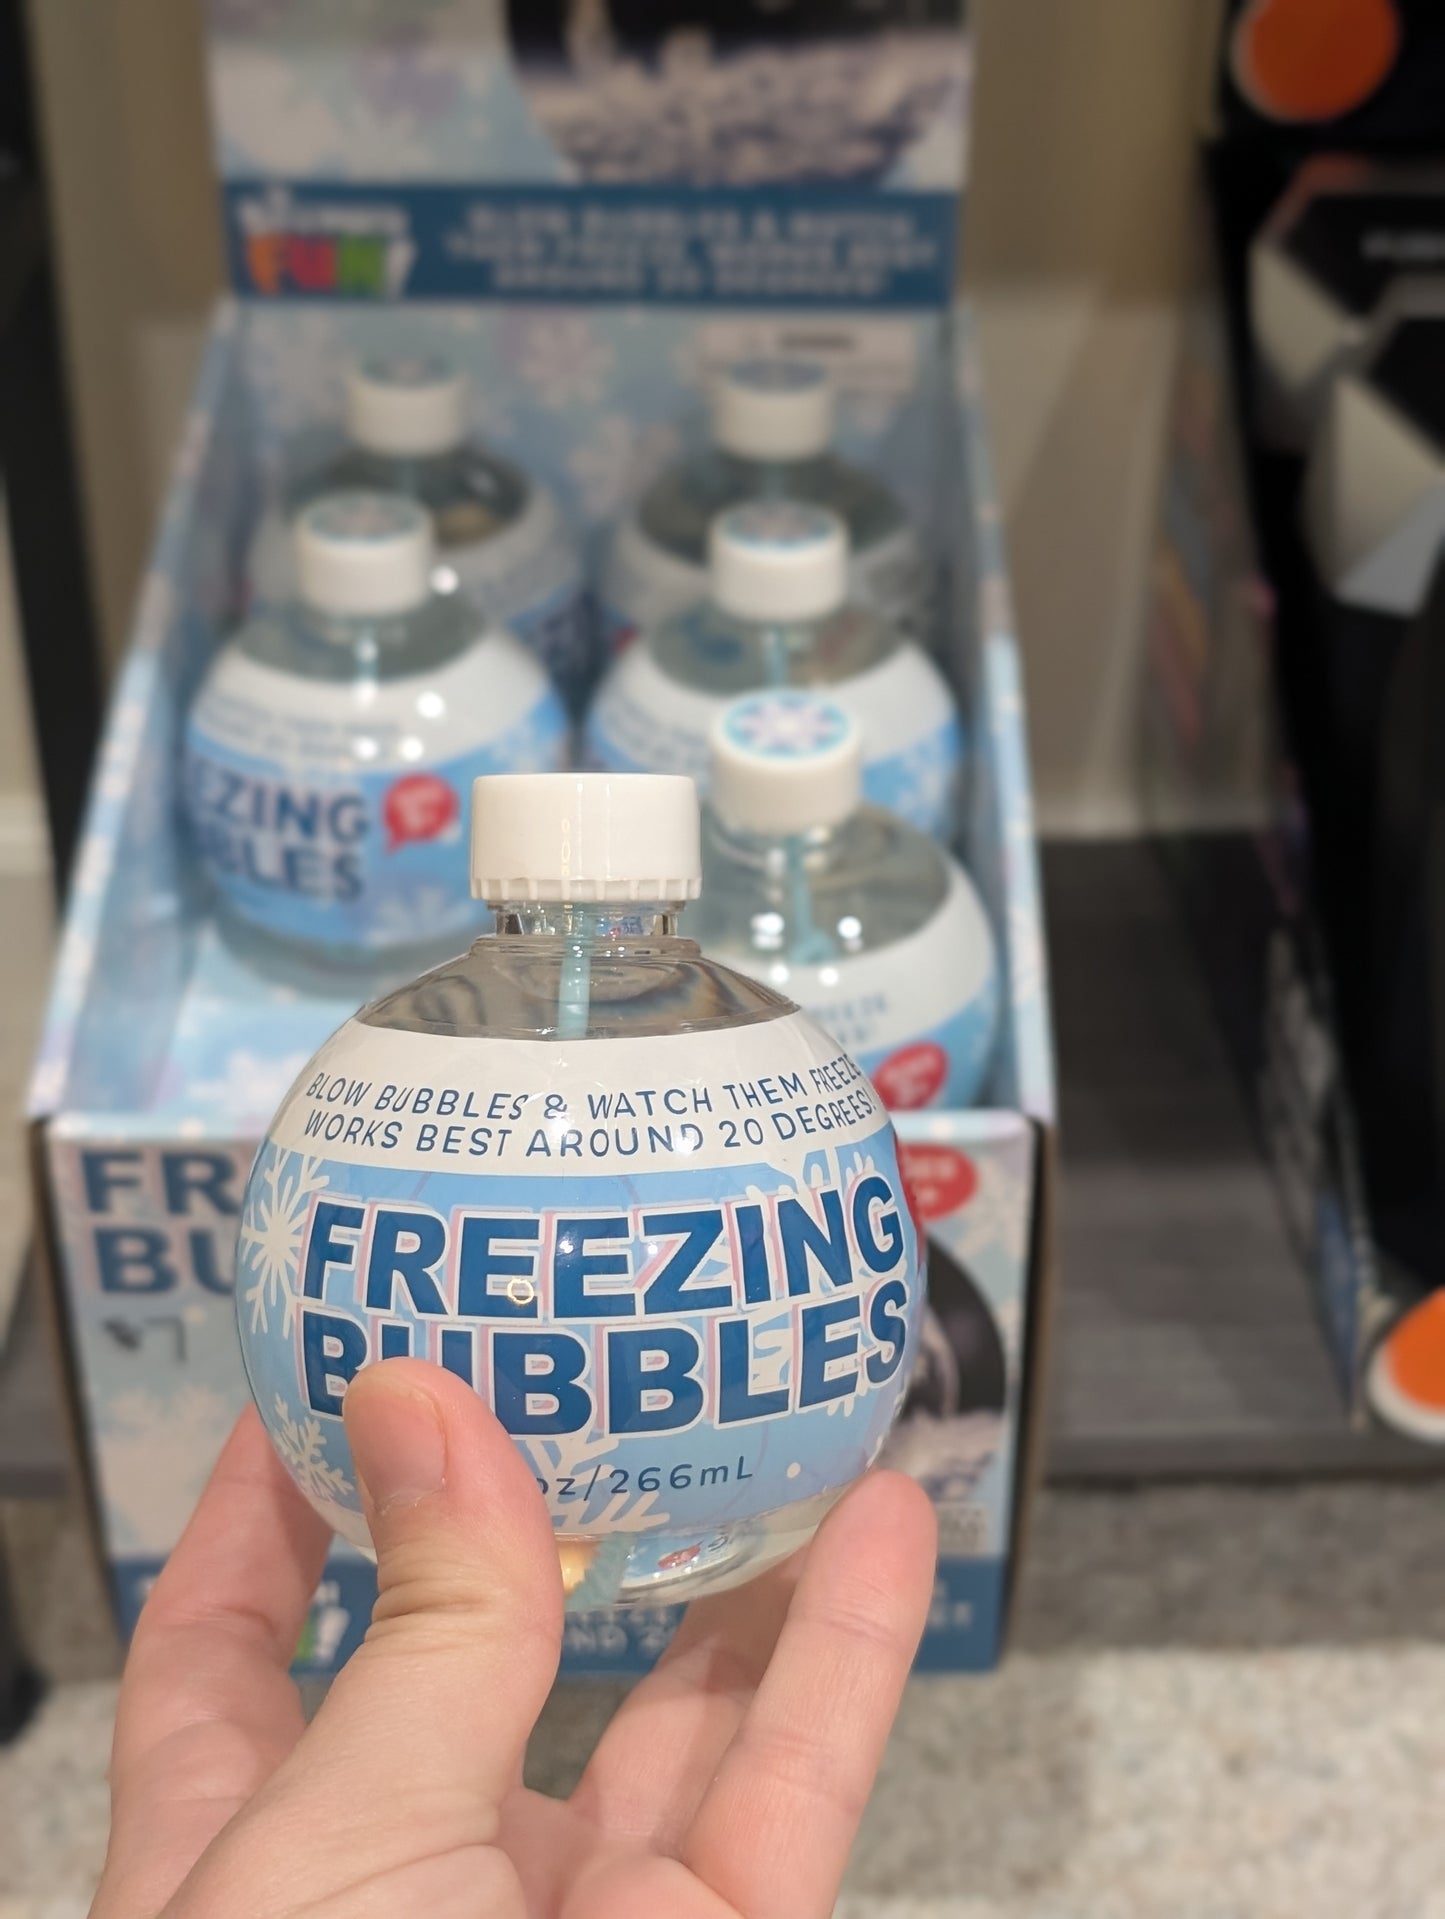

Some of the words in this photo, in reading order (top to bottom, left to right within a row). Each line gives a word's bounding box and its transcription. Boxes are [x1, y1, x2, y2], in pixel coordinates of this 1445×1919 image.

[304, 1111, 403, 1150] WORKS
[416, 1123, 512, 1156] BEST
[525, 1122, 703, 1158] AROUND
[723, 1117, 765, 1149] 20
[771, 1087, 877, 1141] DEGREES!
[306, 1072, 372, 1104] BLOW
[375, 1086, 529, 1121] BUBBLES
[543, 1093, 568, 1120] &
[587, 1087, 711, 1119] WATCH
[722, 1071, 806, 1111] THEM
[302, 1176, 906, 1320] FREEZING
